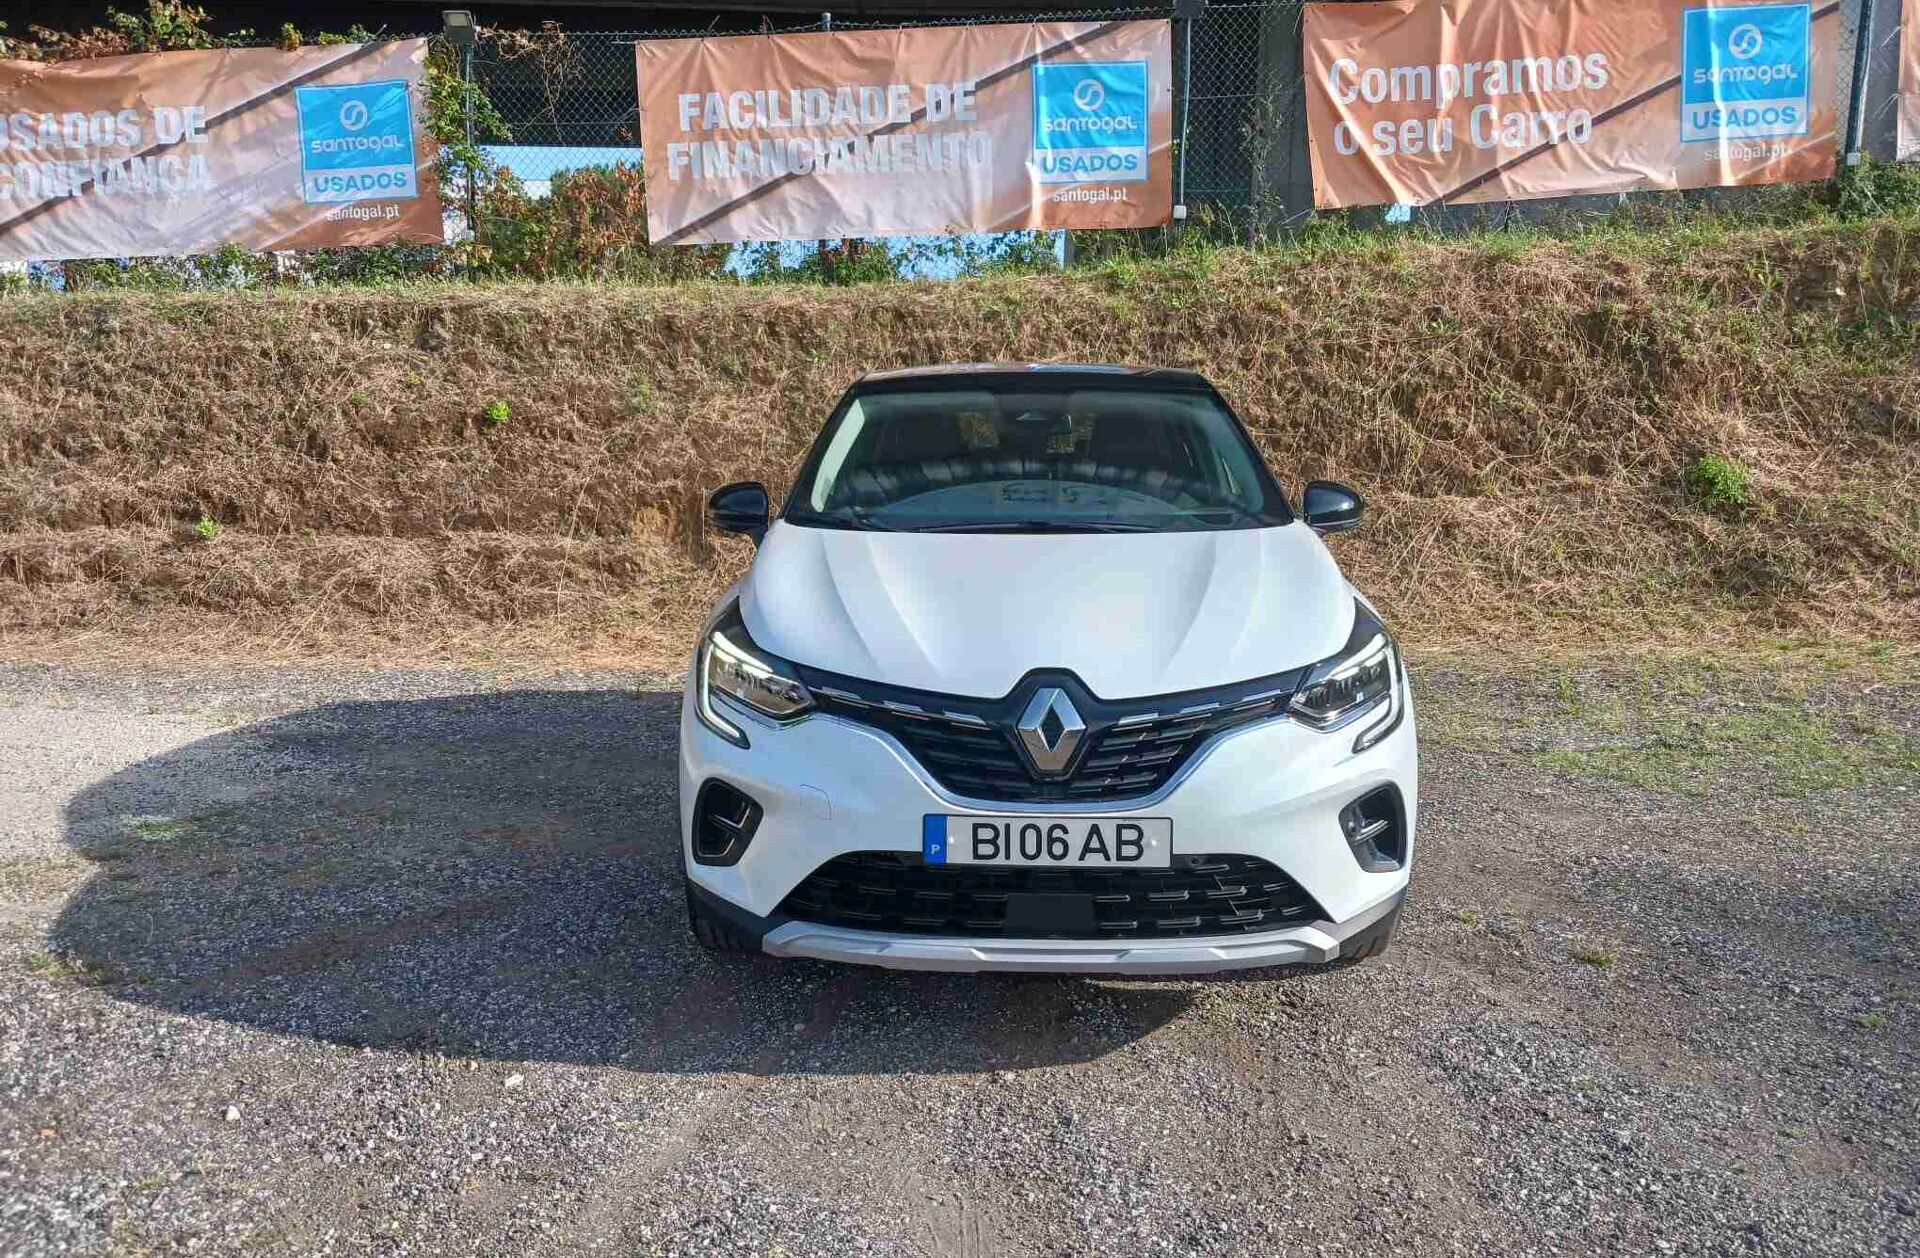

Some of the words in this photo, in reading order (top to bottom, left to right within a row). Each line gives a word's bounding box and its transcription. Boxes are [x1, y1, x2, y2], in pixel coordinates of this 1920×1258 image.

[1330, 52, 1609, 109] Compramos
[678, 82, 912, 132] FACILIDADE
[925, 82, 977, 122] DE
[1692, 105, 1797, 130] USADOS
[153, 105, 210, 145] DE
[1045, 116, 1138, 134] santogal
[1334, 117, 1357, 156] o
[1372, 117, 1453, 157] seu
[1469, 103, 1593, 151] Carro
[311, 134, 405, 154] santogal
[667, 131, 993, 181] FINANCIAMENTO
[1043, 154, 1138, 173] USADOS
[314, 171, 407, 193] USADOS
[1053, 187, 1128, 204] santogal.pt
[327, 204, 400, 221] santogal.pt
[931, 844, 940, 855] P
[971, 822, 1011, 861] BI
[1019, 823, 1069, 861] 06
[1077, 823, 1145, 862] AB
